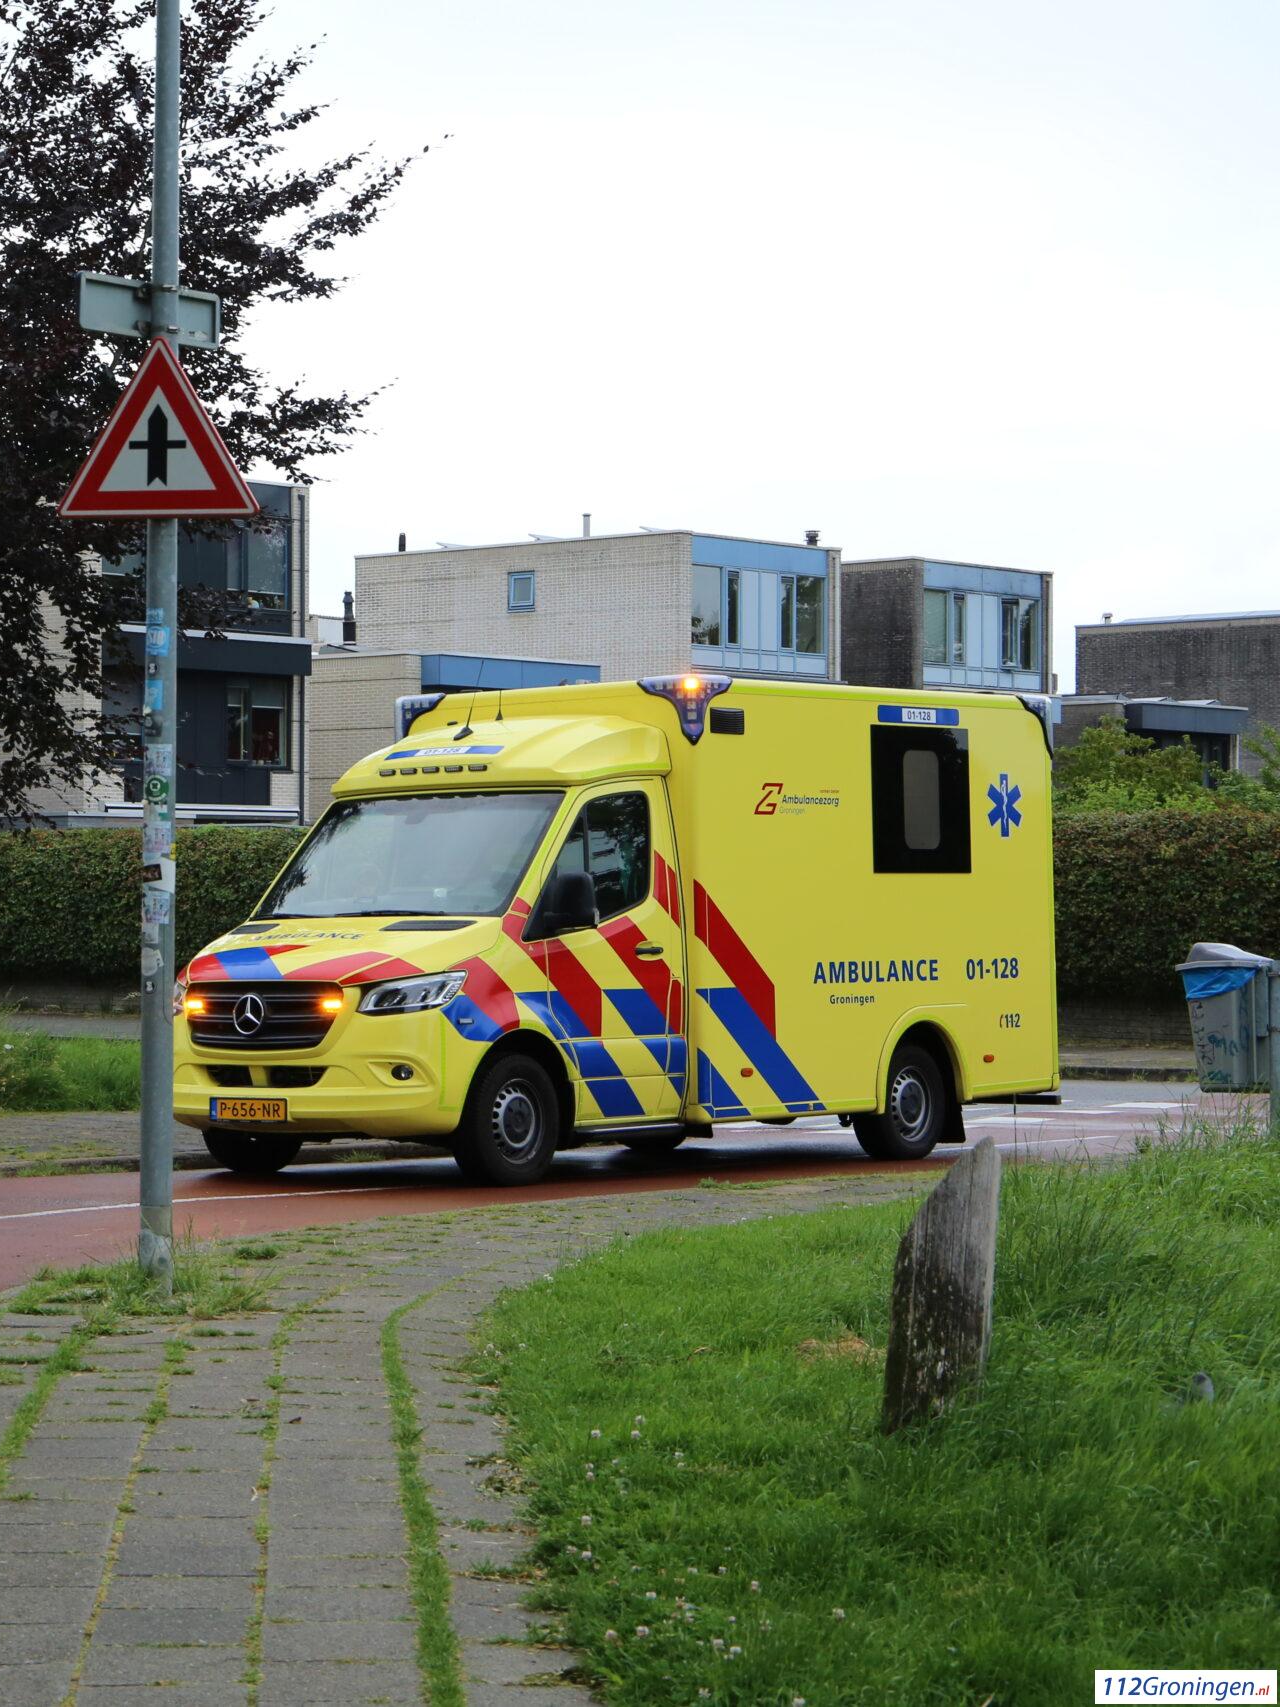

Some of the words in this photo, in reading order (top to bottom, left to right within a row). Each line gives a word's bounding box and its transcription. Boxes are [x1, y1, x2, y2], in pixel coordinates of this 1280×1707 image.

[907, 710, 931, 721] 01-128
[782, 794, 839, 807] Ambulancezorg
[813, 959, 939, 984] AMBULANCE
[966, 957, 1019, 980] 01-128
[829, 994, 875, 1006] Groningen
[220, 1102, 280, 1118] P-656-NR
